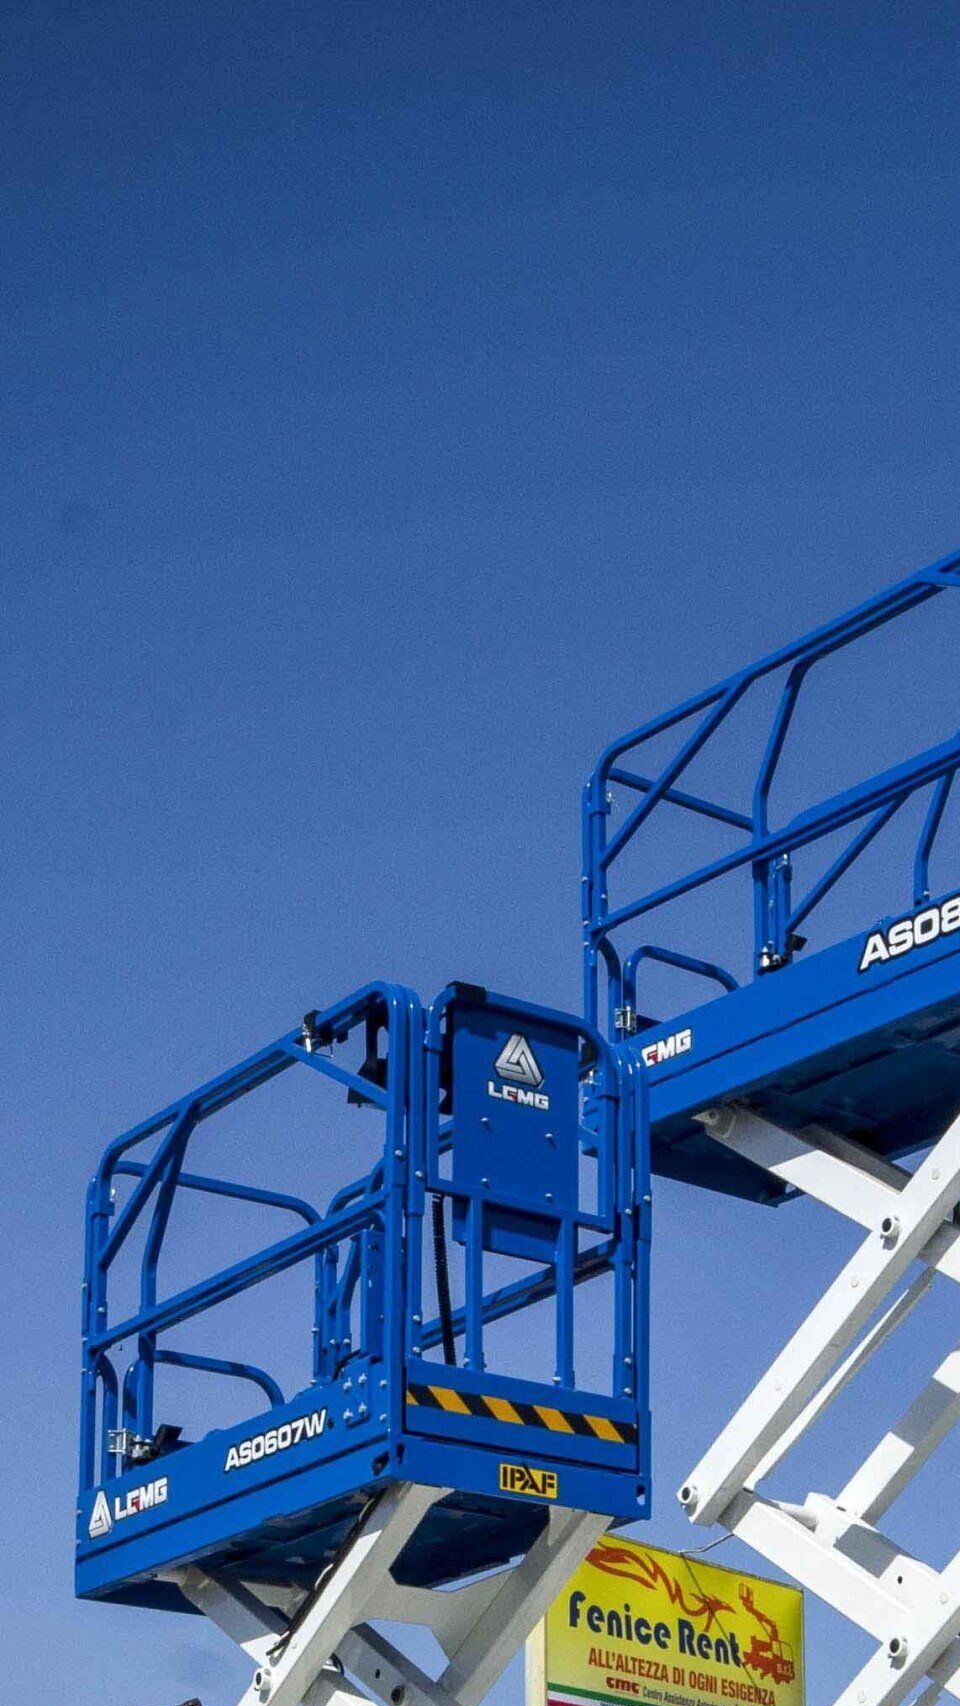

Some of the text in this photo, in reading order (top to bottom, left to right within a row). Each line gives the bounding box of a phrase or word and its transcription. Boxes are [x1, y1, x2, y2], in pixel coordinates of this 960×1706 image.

[642, 1028, 692, 1068] CMG
[488, 1080, 549, 1110] LCMG
[224, 1409, 326, 1472] AS0607W
[114, 1477, 168, 1521] LCMG
[502, 1463, 555, 1495] IPAF
[569, 1590, 744, 1667] Fenice Rent
[588, 1647, 669, 1684] ALL'ALTEZZA
[672, 1666, 685, 1687] DI
[689, 1671, 718, 1694] OGNI
